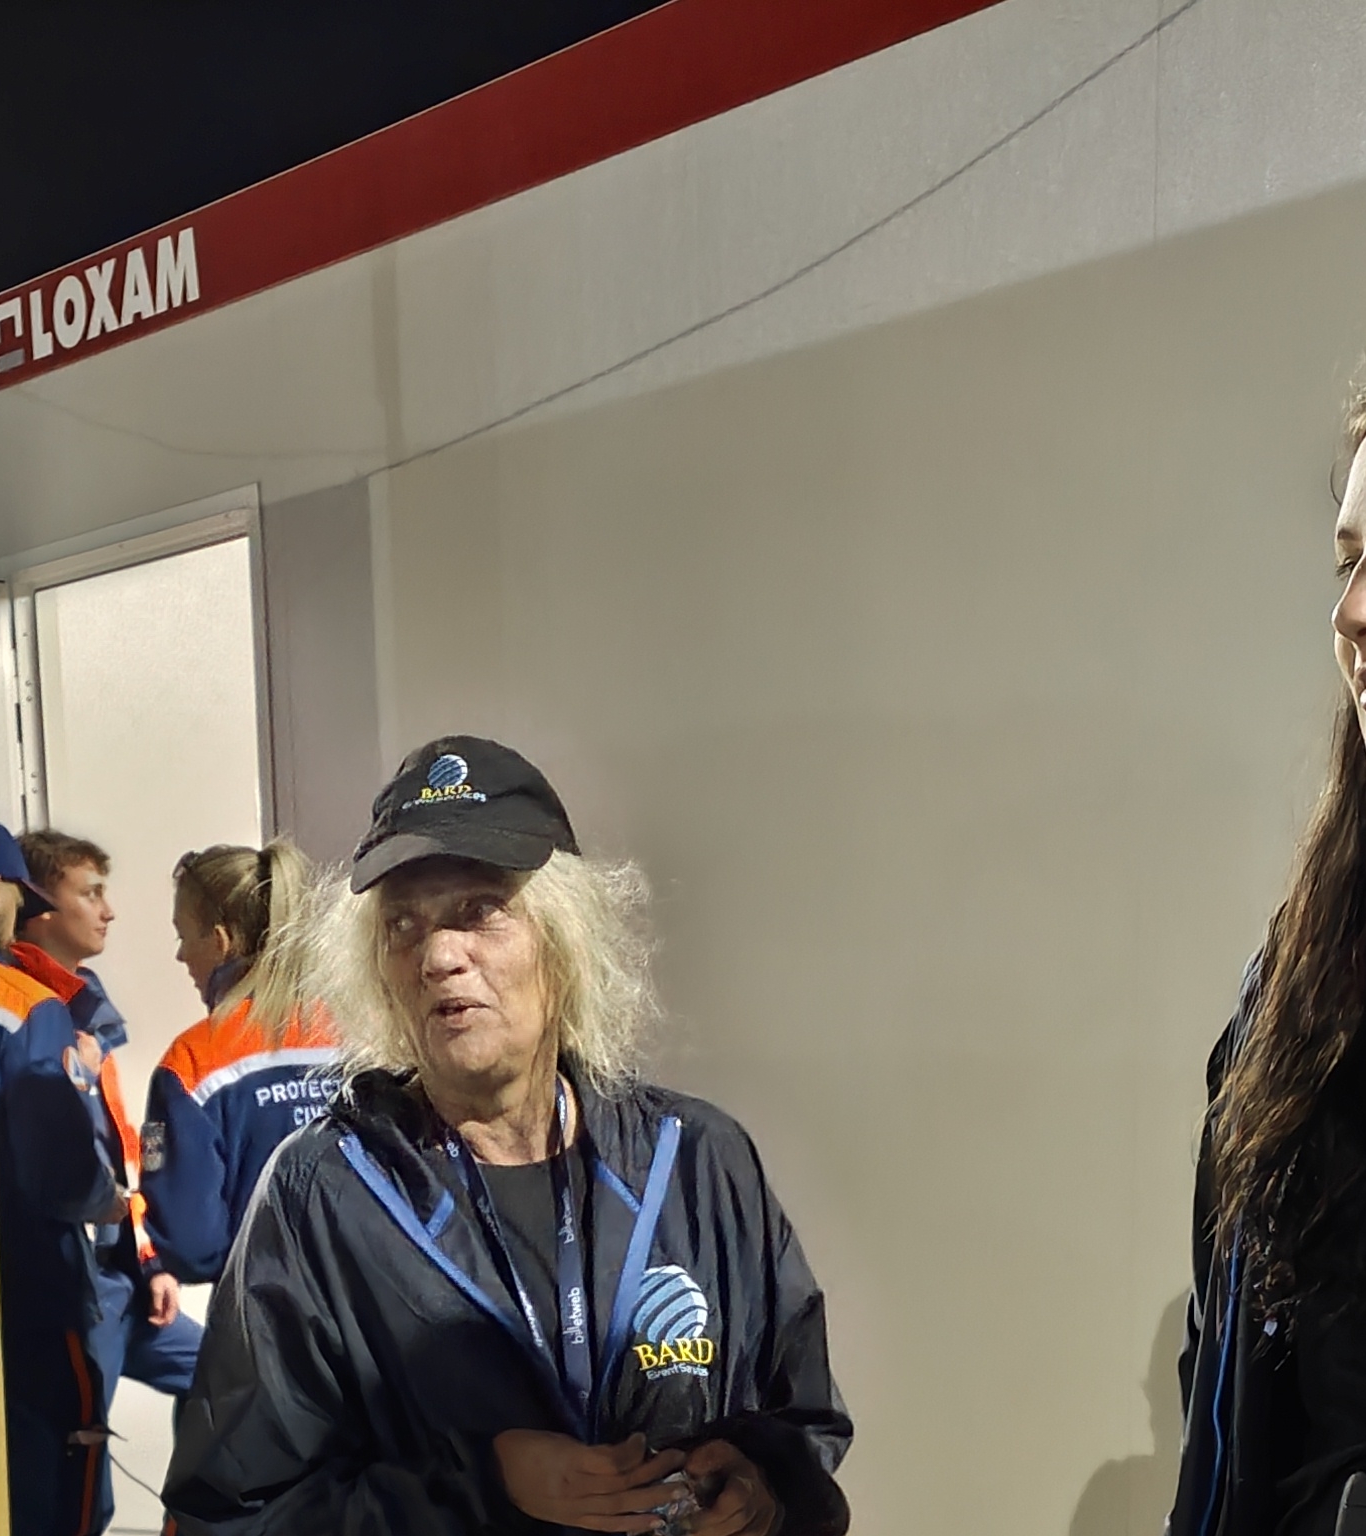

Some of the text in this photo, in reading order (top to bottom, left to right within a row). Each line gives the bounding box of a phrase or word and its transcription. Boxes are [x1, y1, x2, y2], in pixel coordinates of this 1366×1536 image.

[29, 226, 201, 361] LOXAM
[255, 1079, 341, 1107] PROTECT
[293, 1105, 324, 1126] CIV
[563, 1286, 585, 1346] billetweb
[632, 1337, 714, 1372] BARD
